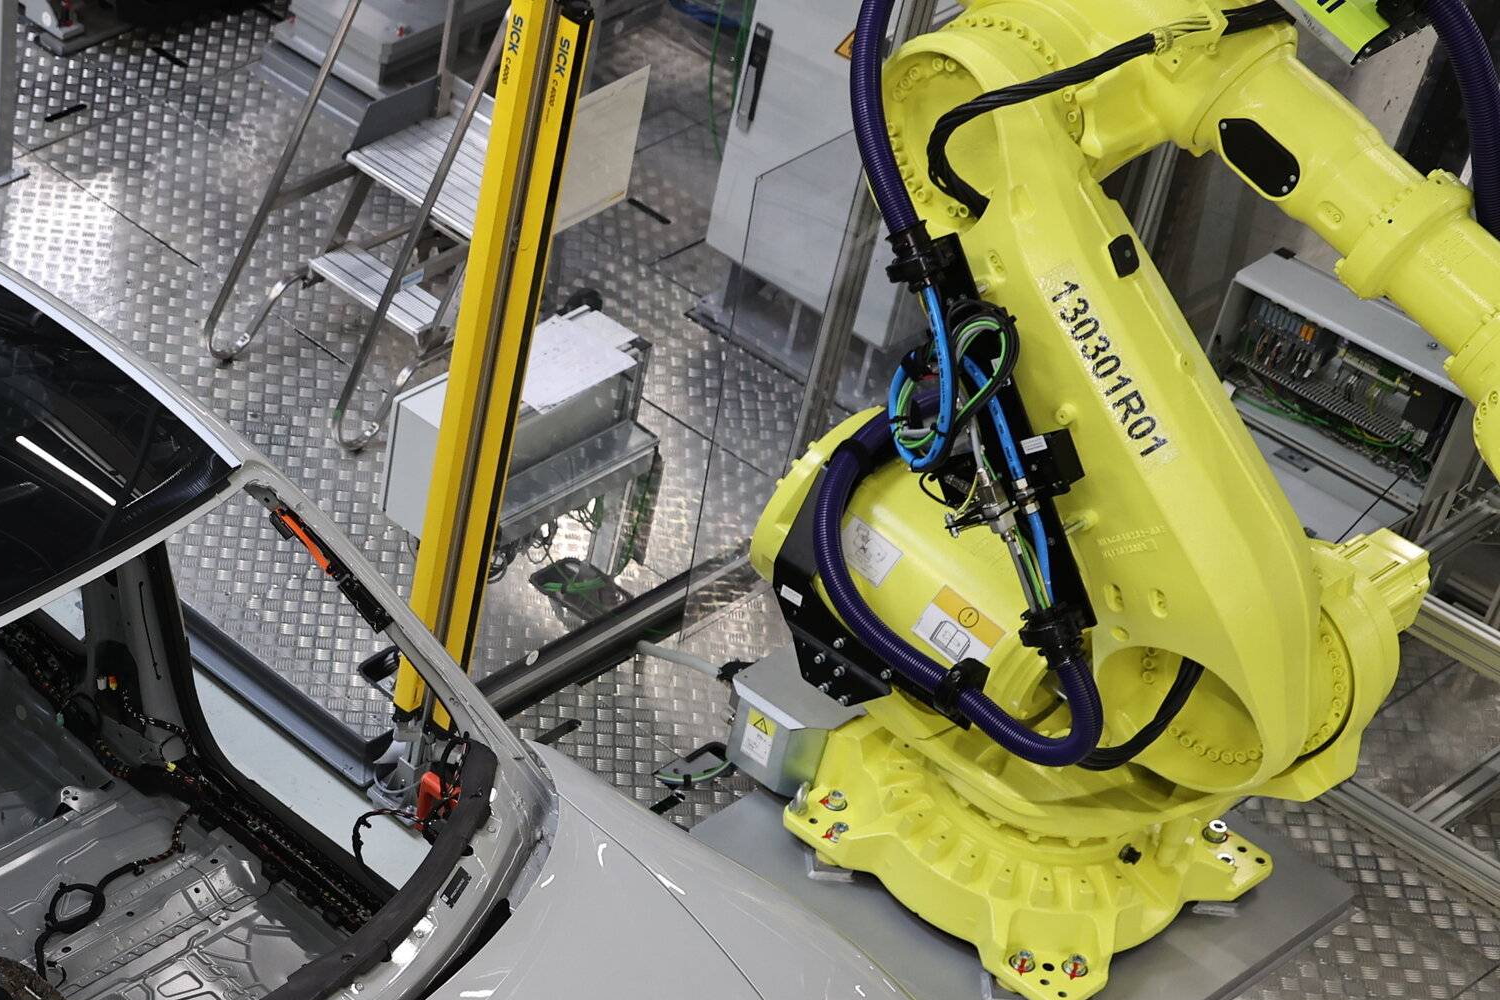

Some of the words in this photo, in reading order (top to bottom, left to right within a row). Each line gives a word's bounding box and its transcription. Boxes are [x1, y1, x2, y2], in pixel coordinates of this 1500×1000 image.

[508, 14, 523, 56] SICK
[555, 36, 570, 78] SICK
[1052, 281, 1168, 457] 130301R01
